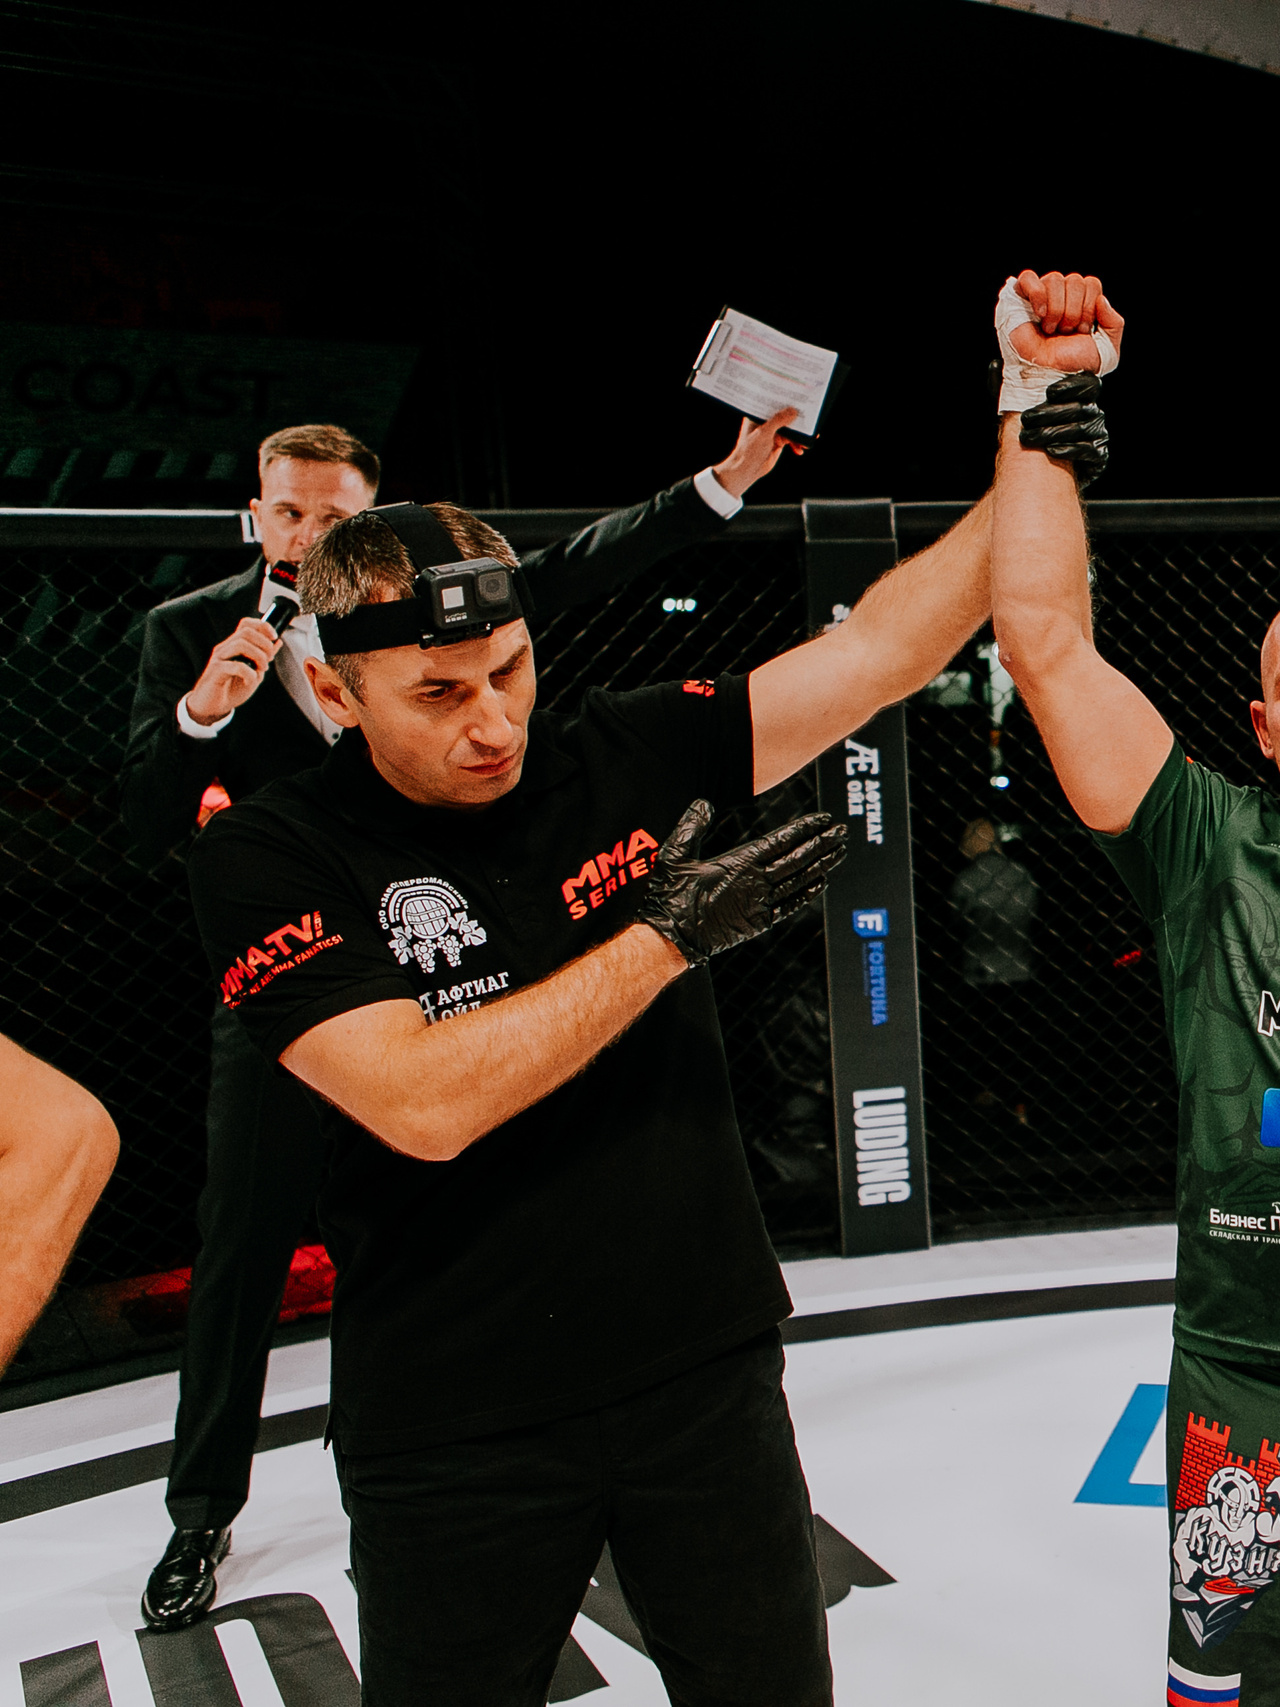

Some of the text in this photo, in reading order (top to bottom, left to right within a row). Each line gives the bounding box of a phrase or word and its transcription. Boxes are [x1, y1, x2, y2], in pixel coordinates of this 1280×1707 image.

[561, 828, 659, 904] MMA
[437, 971, 509, 1006] АФТИАГ
[868, 941, 889, 1026] FORTUNA
[852, 1086, 912, 1207] LUDING
[1208, 1229, 1251, 1242] СКЛАДСКАЯ
[1253, 1235, 1260, 1243] И
[1209, 1207, 1267, 1231] Бизнес
